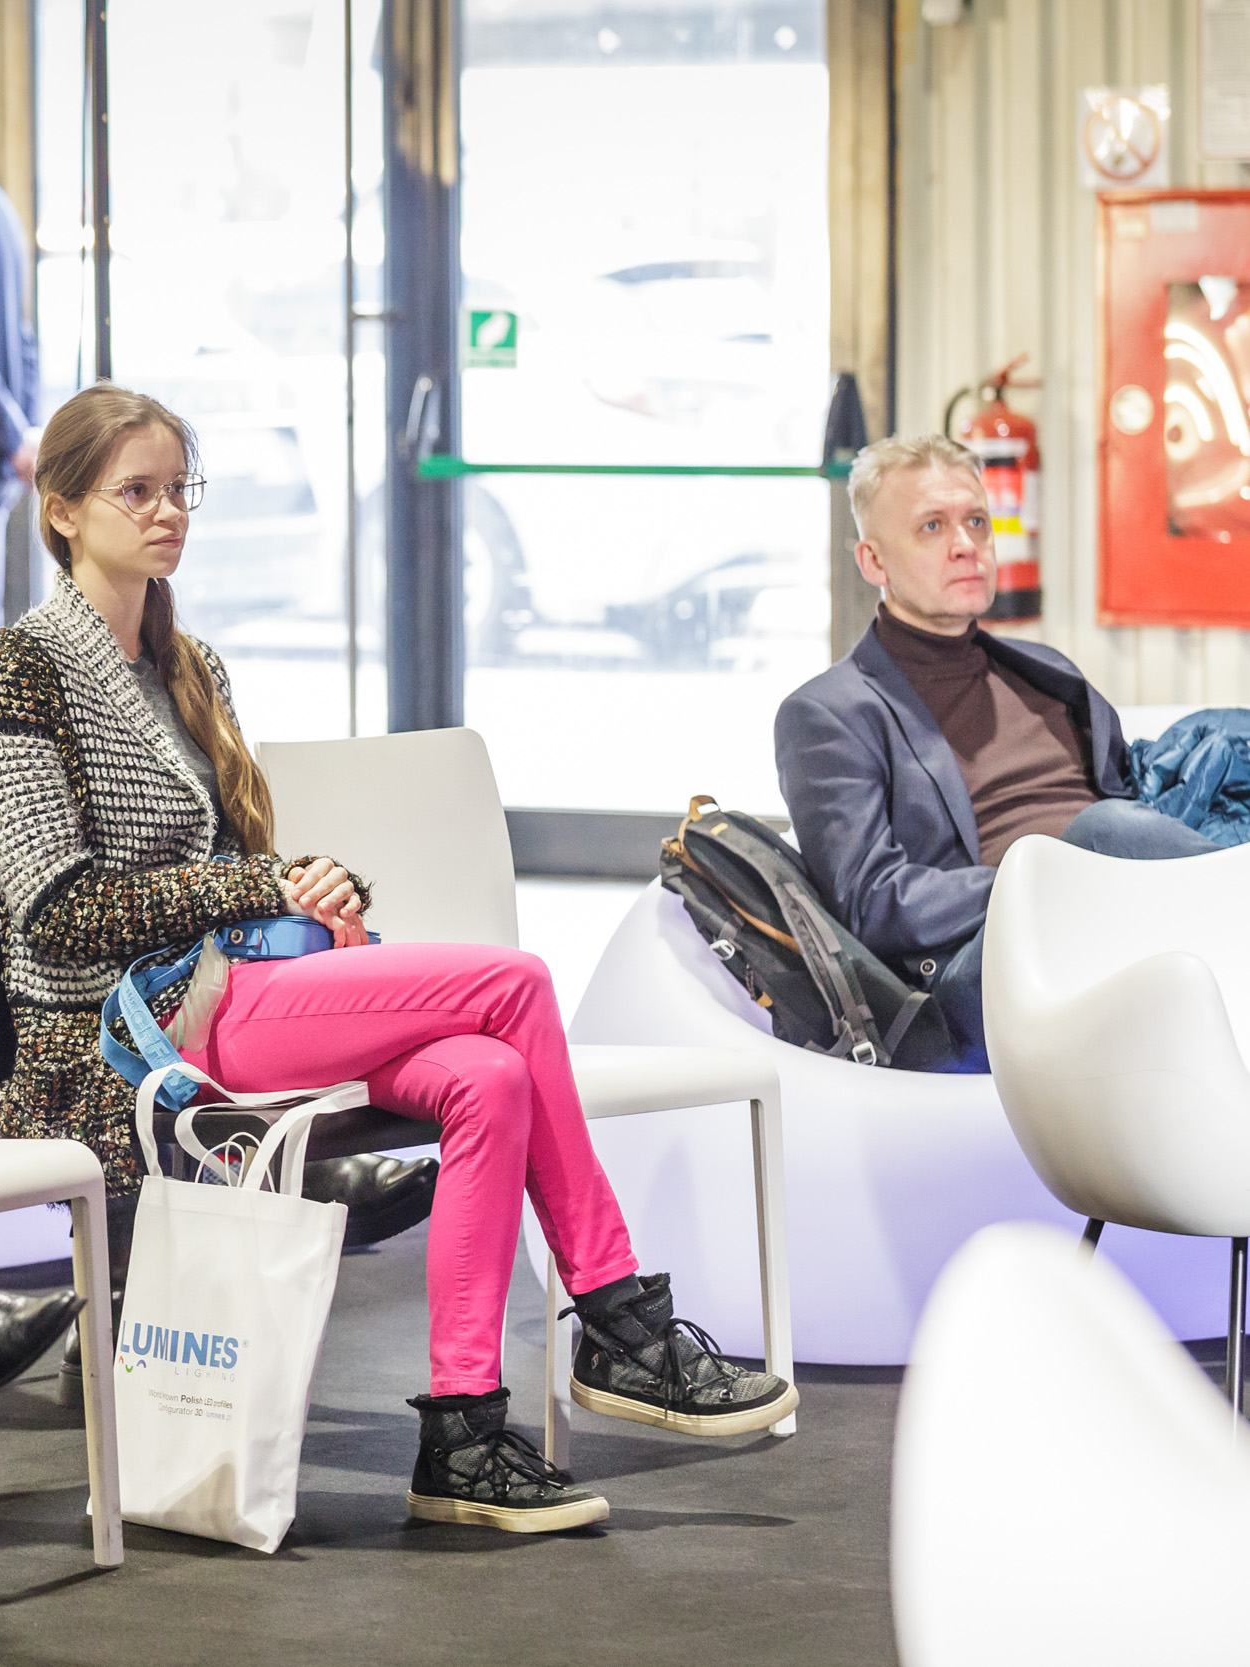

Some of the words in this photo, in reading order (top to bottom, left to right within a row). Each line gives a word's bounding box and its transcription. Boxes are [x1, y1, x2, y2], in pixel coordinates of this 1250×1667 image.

[120, 1320, 239, 1369] LUMINES
[175, 1367, 235, 1382] LIGHTING
[180, 1394, 204, 1405] Polish
[194, 1408, 203, 1417] 3D
